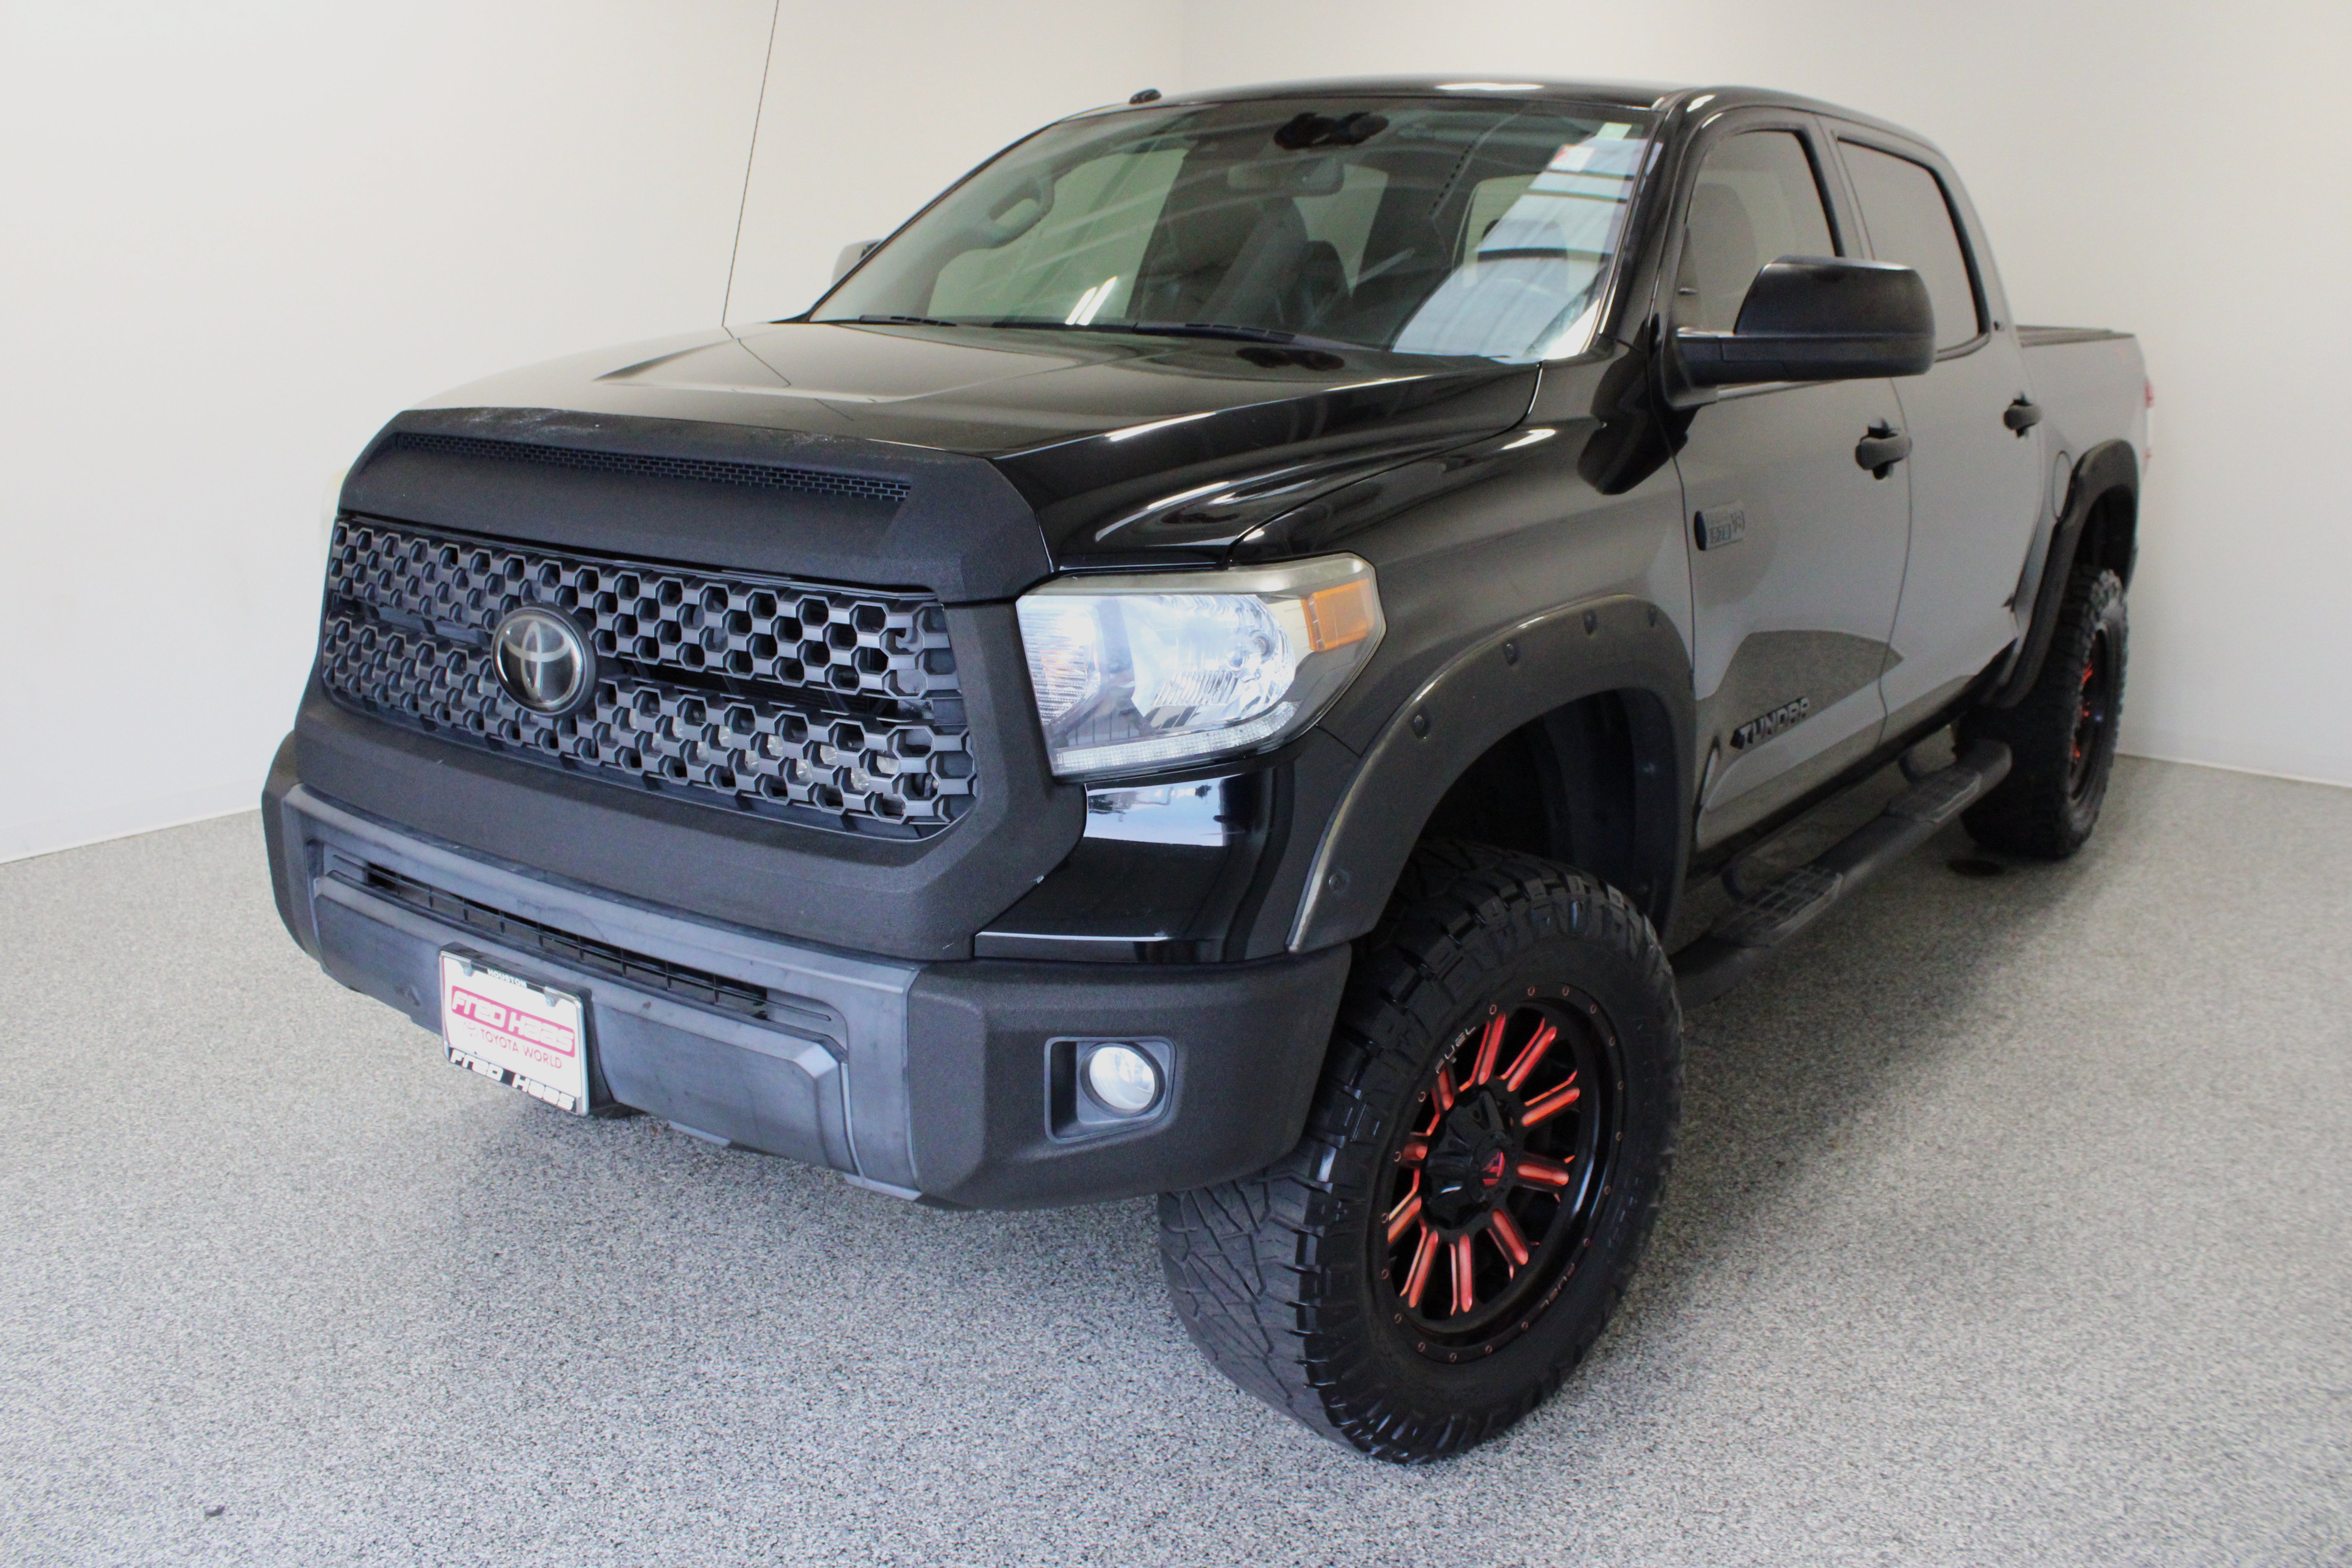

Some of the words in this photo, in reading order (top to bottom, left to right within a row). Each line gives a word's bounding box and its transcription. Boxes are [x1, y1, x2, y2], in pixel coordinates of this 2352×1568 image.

[487, 968, 527, 988] HOUSTON
[480, 1029, 519, 1054] TOYOTA
[523, 1045, 562, 1069] WORLD
